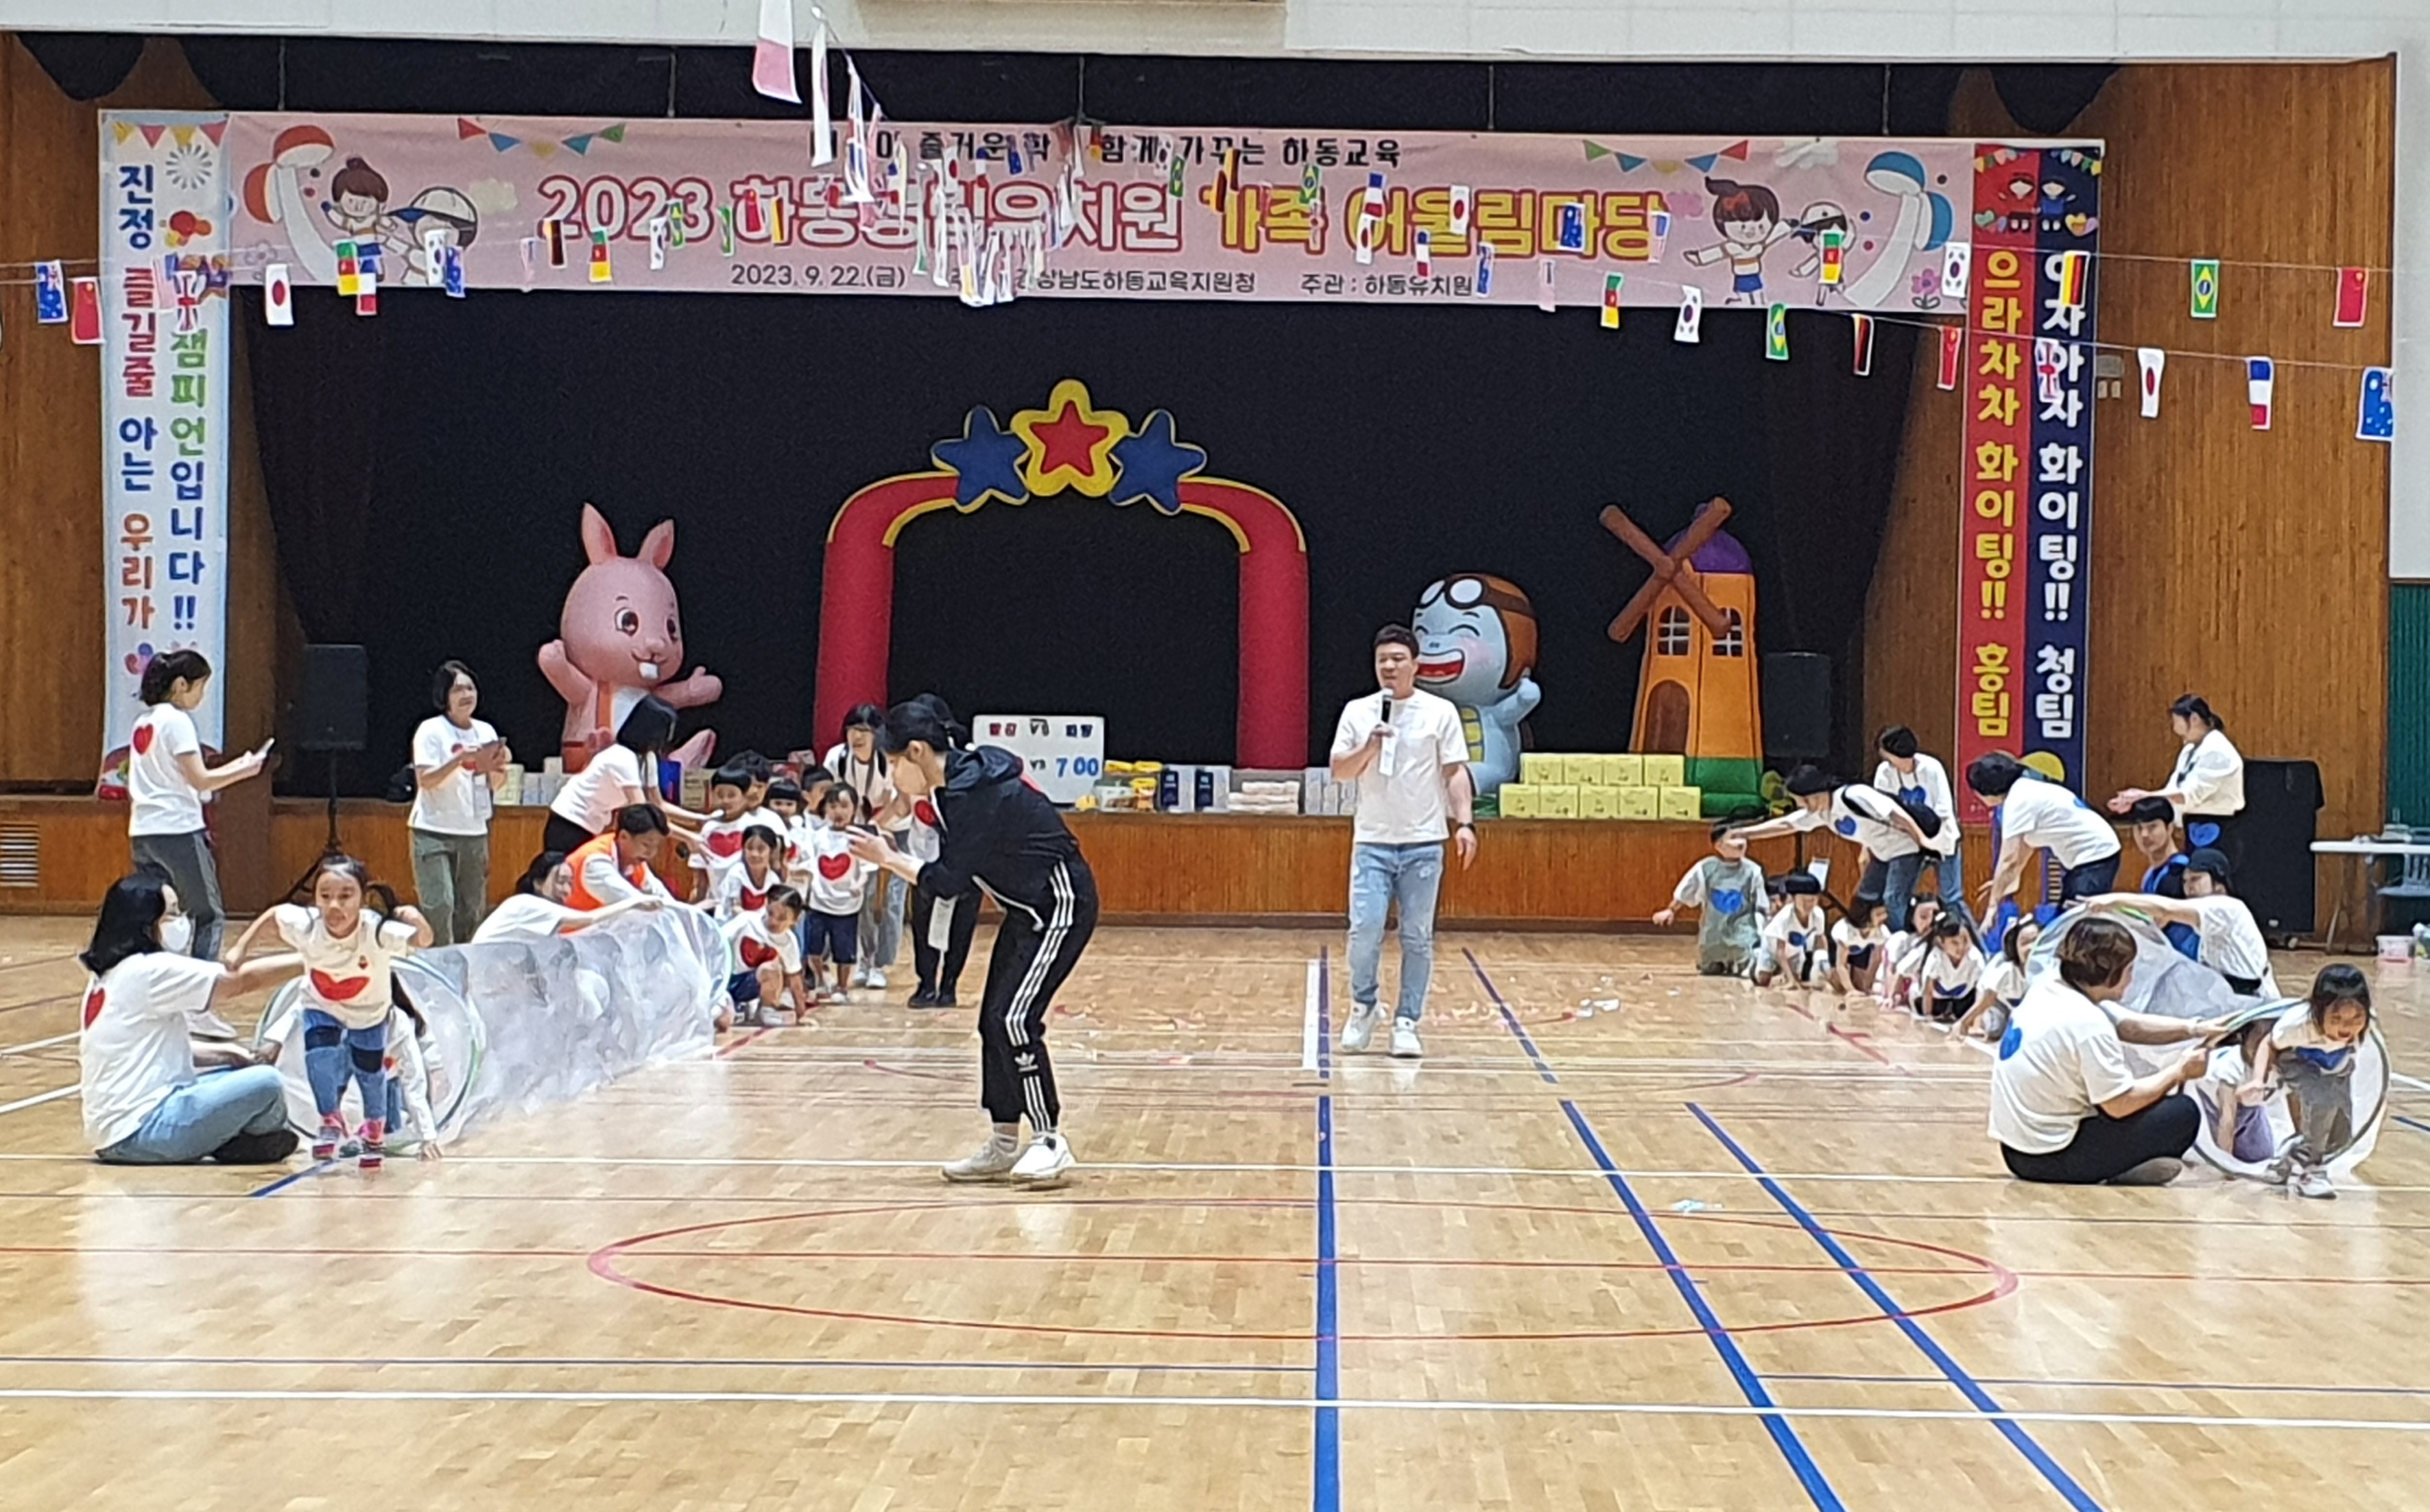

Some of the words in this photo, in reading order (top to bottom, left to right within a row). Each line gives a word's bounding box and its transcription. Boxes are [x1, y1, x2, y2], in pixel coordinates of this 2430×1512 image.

[1179, 135, 1265, 166] 가꾸는
[1283, 139, 1402, 168] 하동교육
[118, 165, 155, 250] 진정
[538, 176, 713, 241] 2023
[1199, 184, 1328, 254] 가족
[1344, 187, 1669, 259] 어울림마당
[1301, 274, 1346, 295] 주관
[1364, 275, 1473, 297] 하동유치원
[1977, 250, 2023, 427] 으라차차
[119, 417, 158, 492] 아는
[121, 513, 155, 629] 우리가
[1975, 441, 2018, 619] 화이팅!!
[2038, 442, 2083, 621] 화이팅!!
[1971, 643, 2010, 736] 홍팀
[2036, 645, 2075, 739] 청팀
